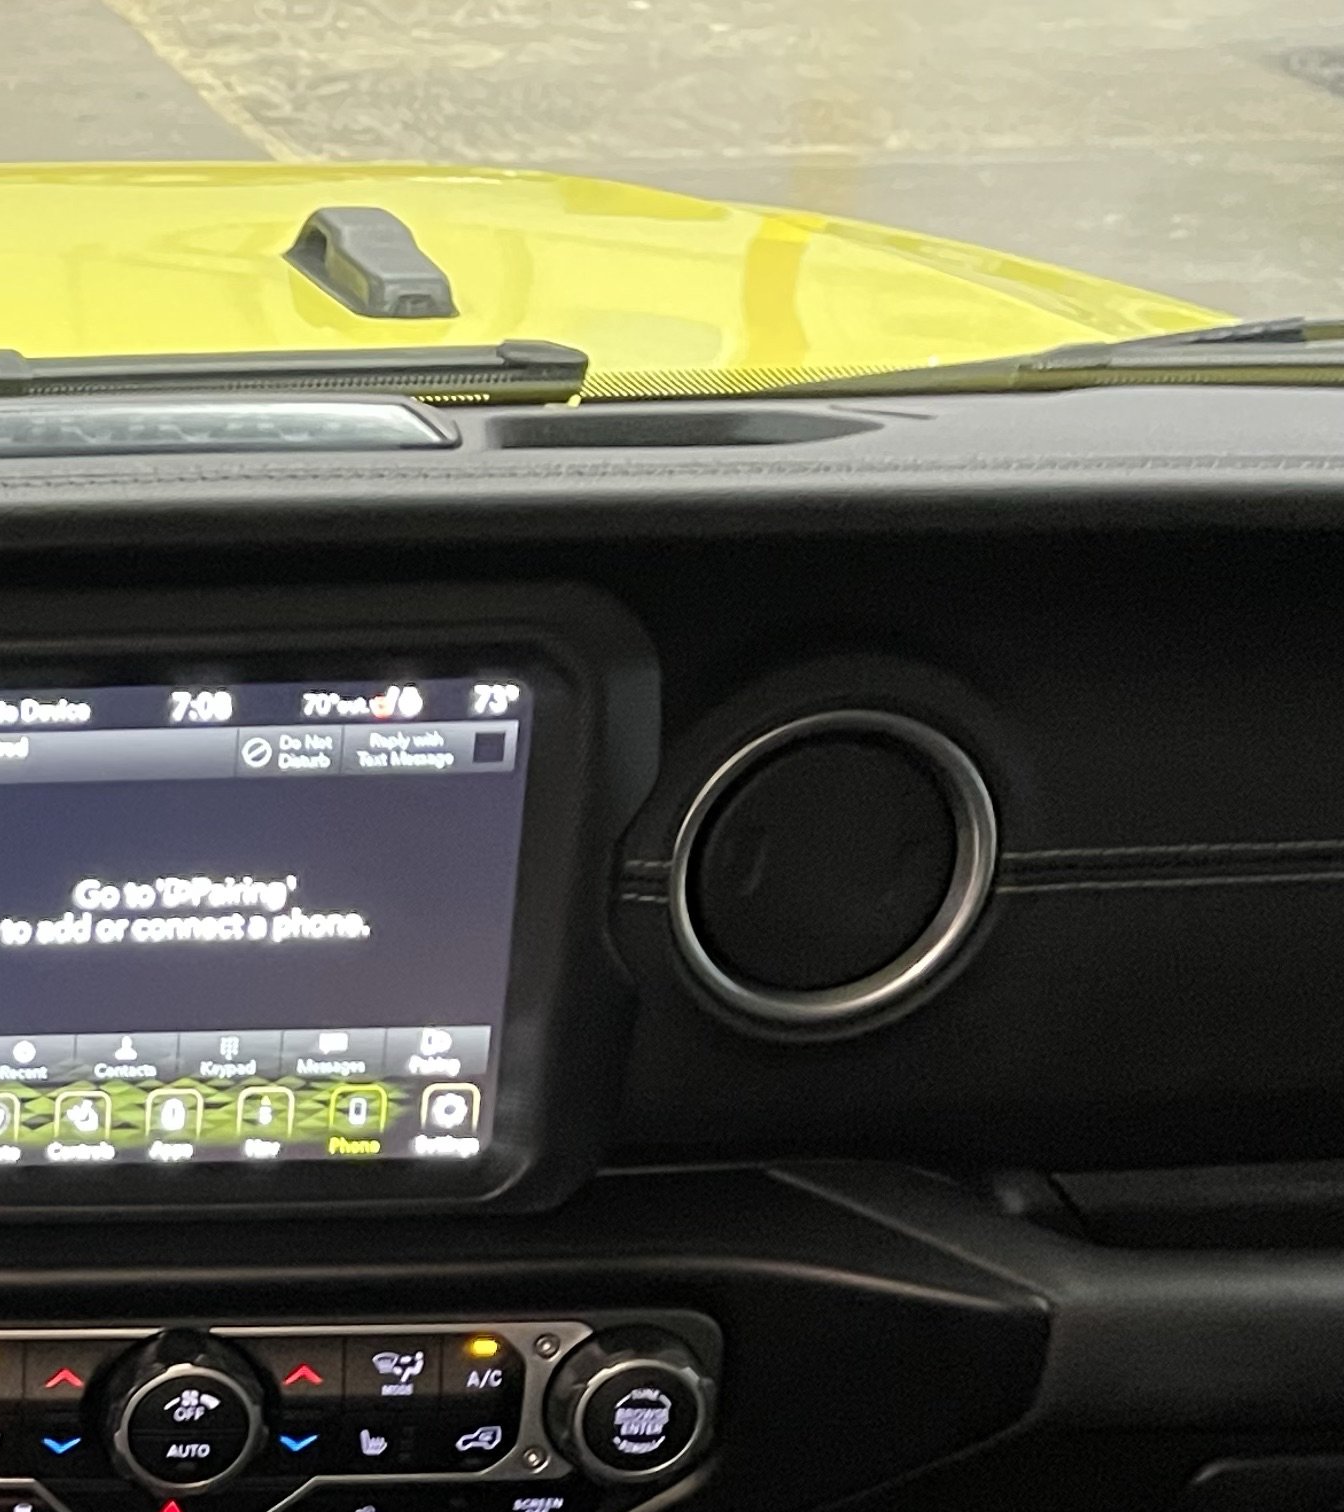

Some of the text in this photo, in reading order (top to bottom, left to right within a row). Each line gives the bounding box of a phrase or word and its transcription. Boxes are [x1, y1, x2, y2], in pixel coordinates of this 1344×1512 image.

[20, 698, 91, 723] Device
[279, 734, 333, 751] Do Not
[278, 752, 331, 769] Disturb
[357, 751, 454, 770] Text Message
[74, 879, 120, 910] Go
[123, 882, 157, 910] to
[0, 907, 370, 945] to add or connect a phone.
[94, 1063, 157, 1080] Contacts
[200, 1060, 256, 1079] Keypad
[297, 1059, 366, 1076] Messages
[329, 1137, 380, 1155] Phone
[467, 1369, 502, 1388] A/C
[173, 1407, 205, 1422] OFF
[166, 1444, 211, 1458] AUTO
